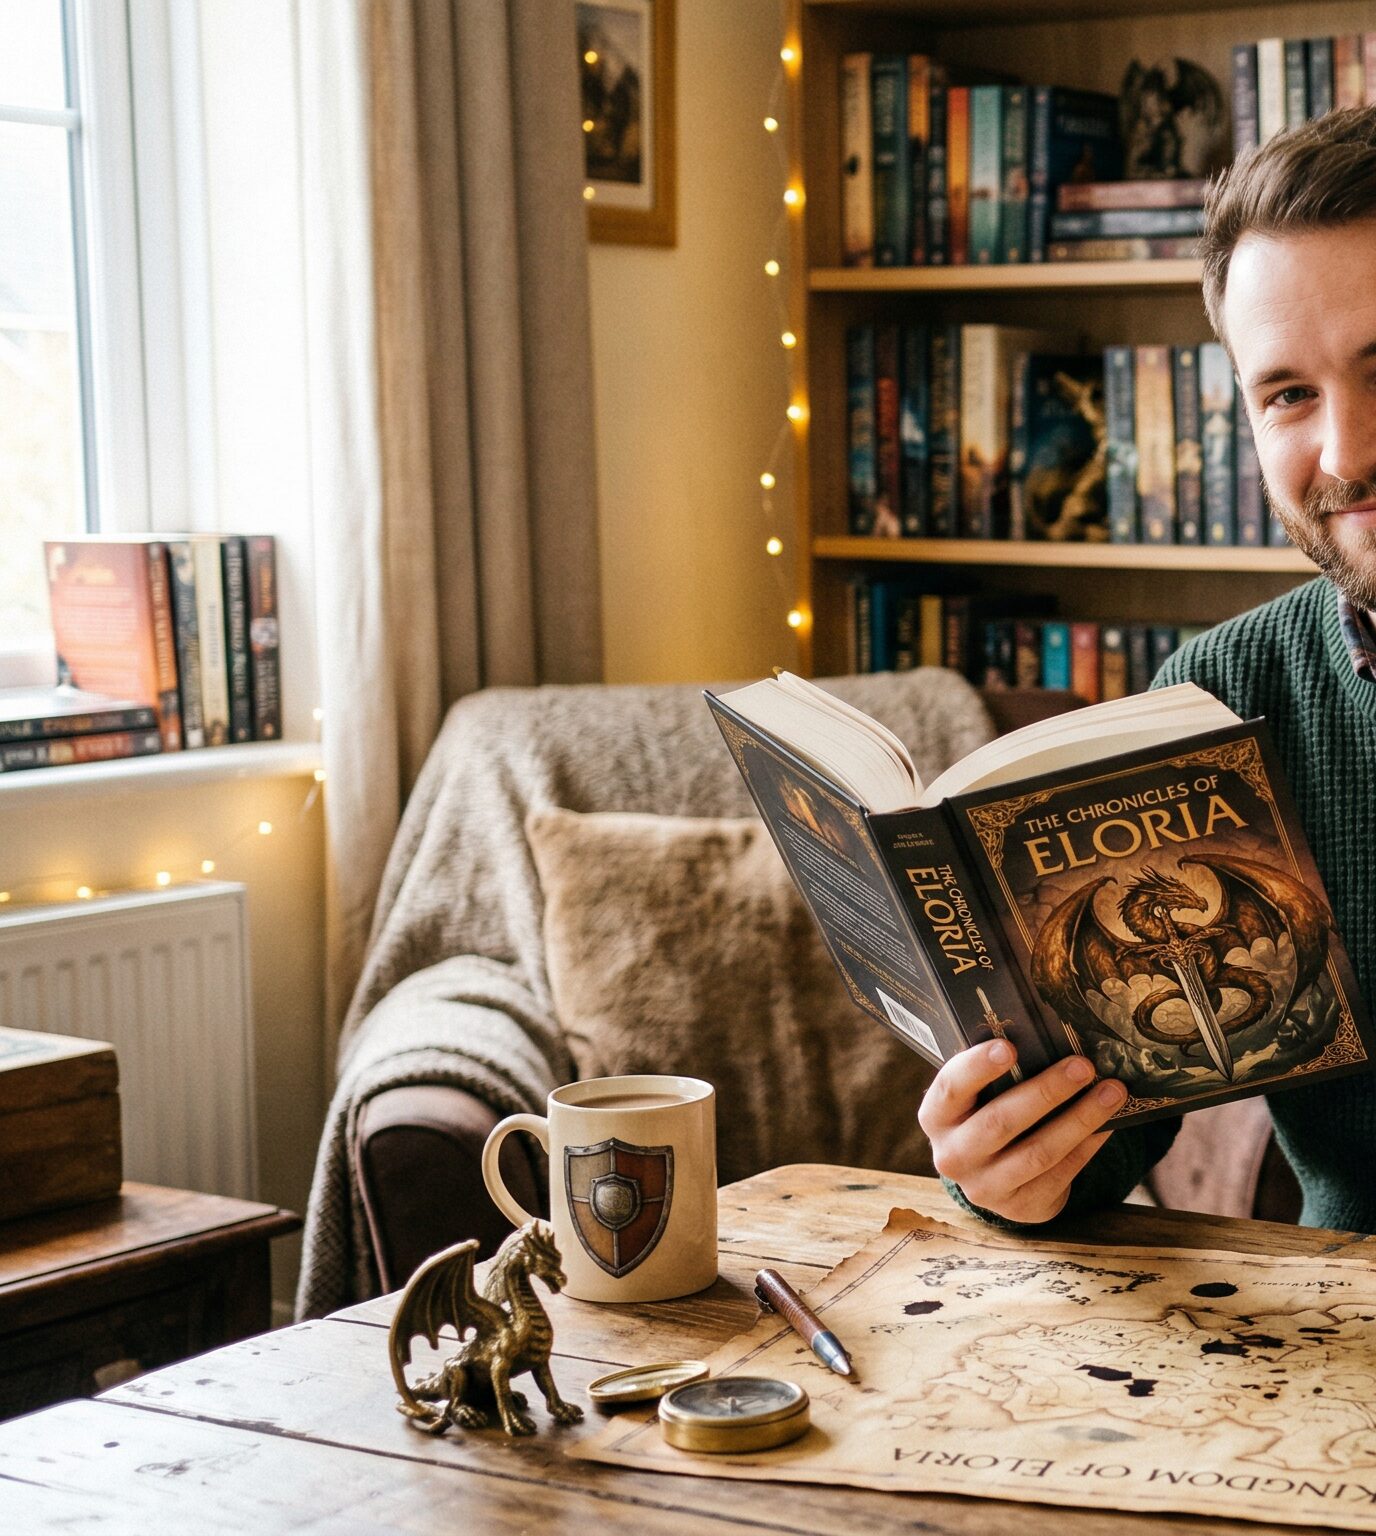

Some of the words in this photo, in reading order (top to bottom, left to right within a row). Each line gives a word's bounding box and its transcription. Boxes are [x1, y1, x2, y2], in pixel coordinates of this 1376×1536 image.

[1023, 811, 1064, 835] THE
[1066, 782, 1189, 826] CHRONICLES
[1192, 774, 1221, 796] OF
[1022, 794, 1249, 876] ELORIA
[938, 864, 959, 886] THE
[905, 866, 978, 976] ELORIA
[948, 887, 987, 955] CHRONICLES
[977, 956, 994, 971] OF
[891, 1446, 1054, 1479] ELORIA
[1066, 1463, 1132, 1479] OF
